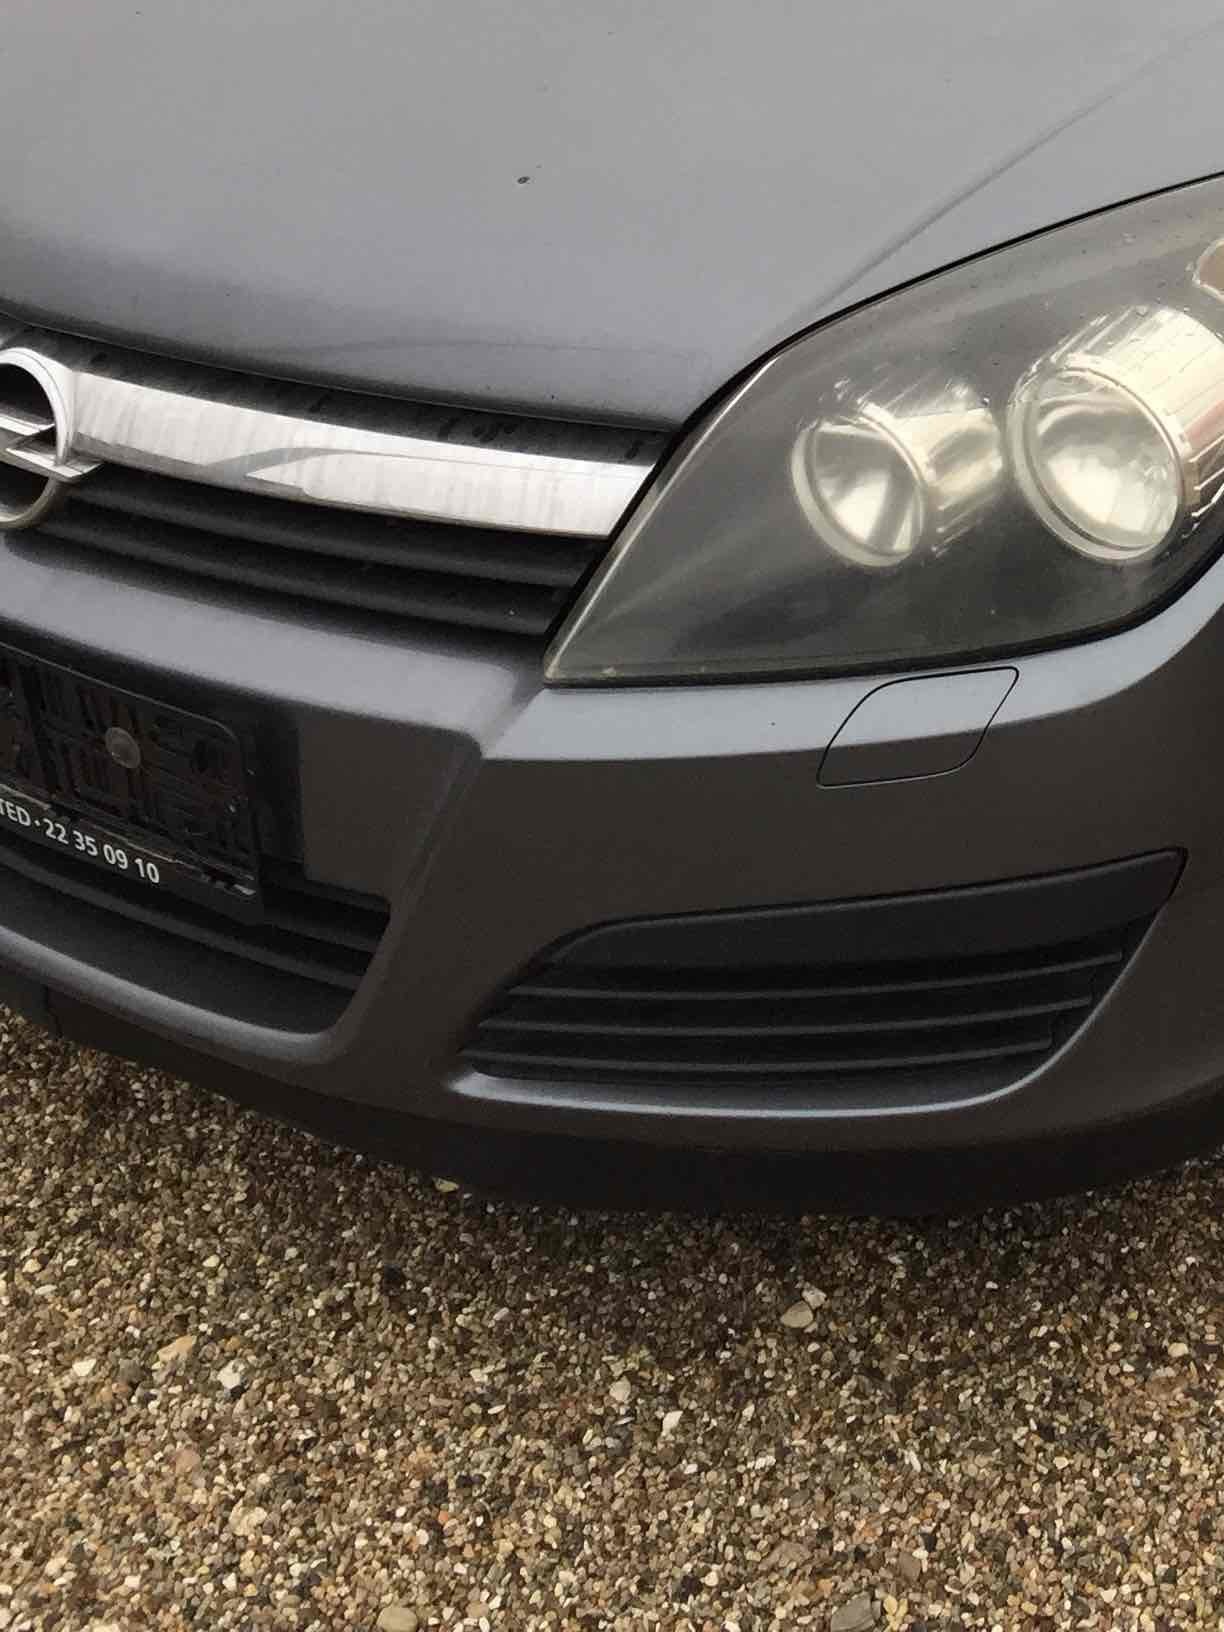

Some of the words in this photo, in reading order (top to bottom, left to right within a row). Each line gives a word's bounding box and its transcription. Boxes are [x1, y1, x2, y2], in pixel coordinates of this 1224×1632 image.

[44, 818, 69, 845] 22
[73, 829, 98, 857] 35
[103, 843, 128, 870] 09
[134, 857, 160, 884] 10
